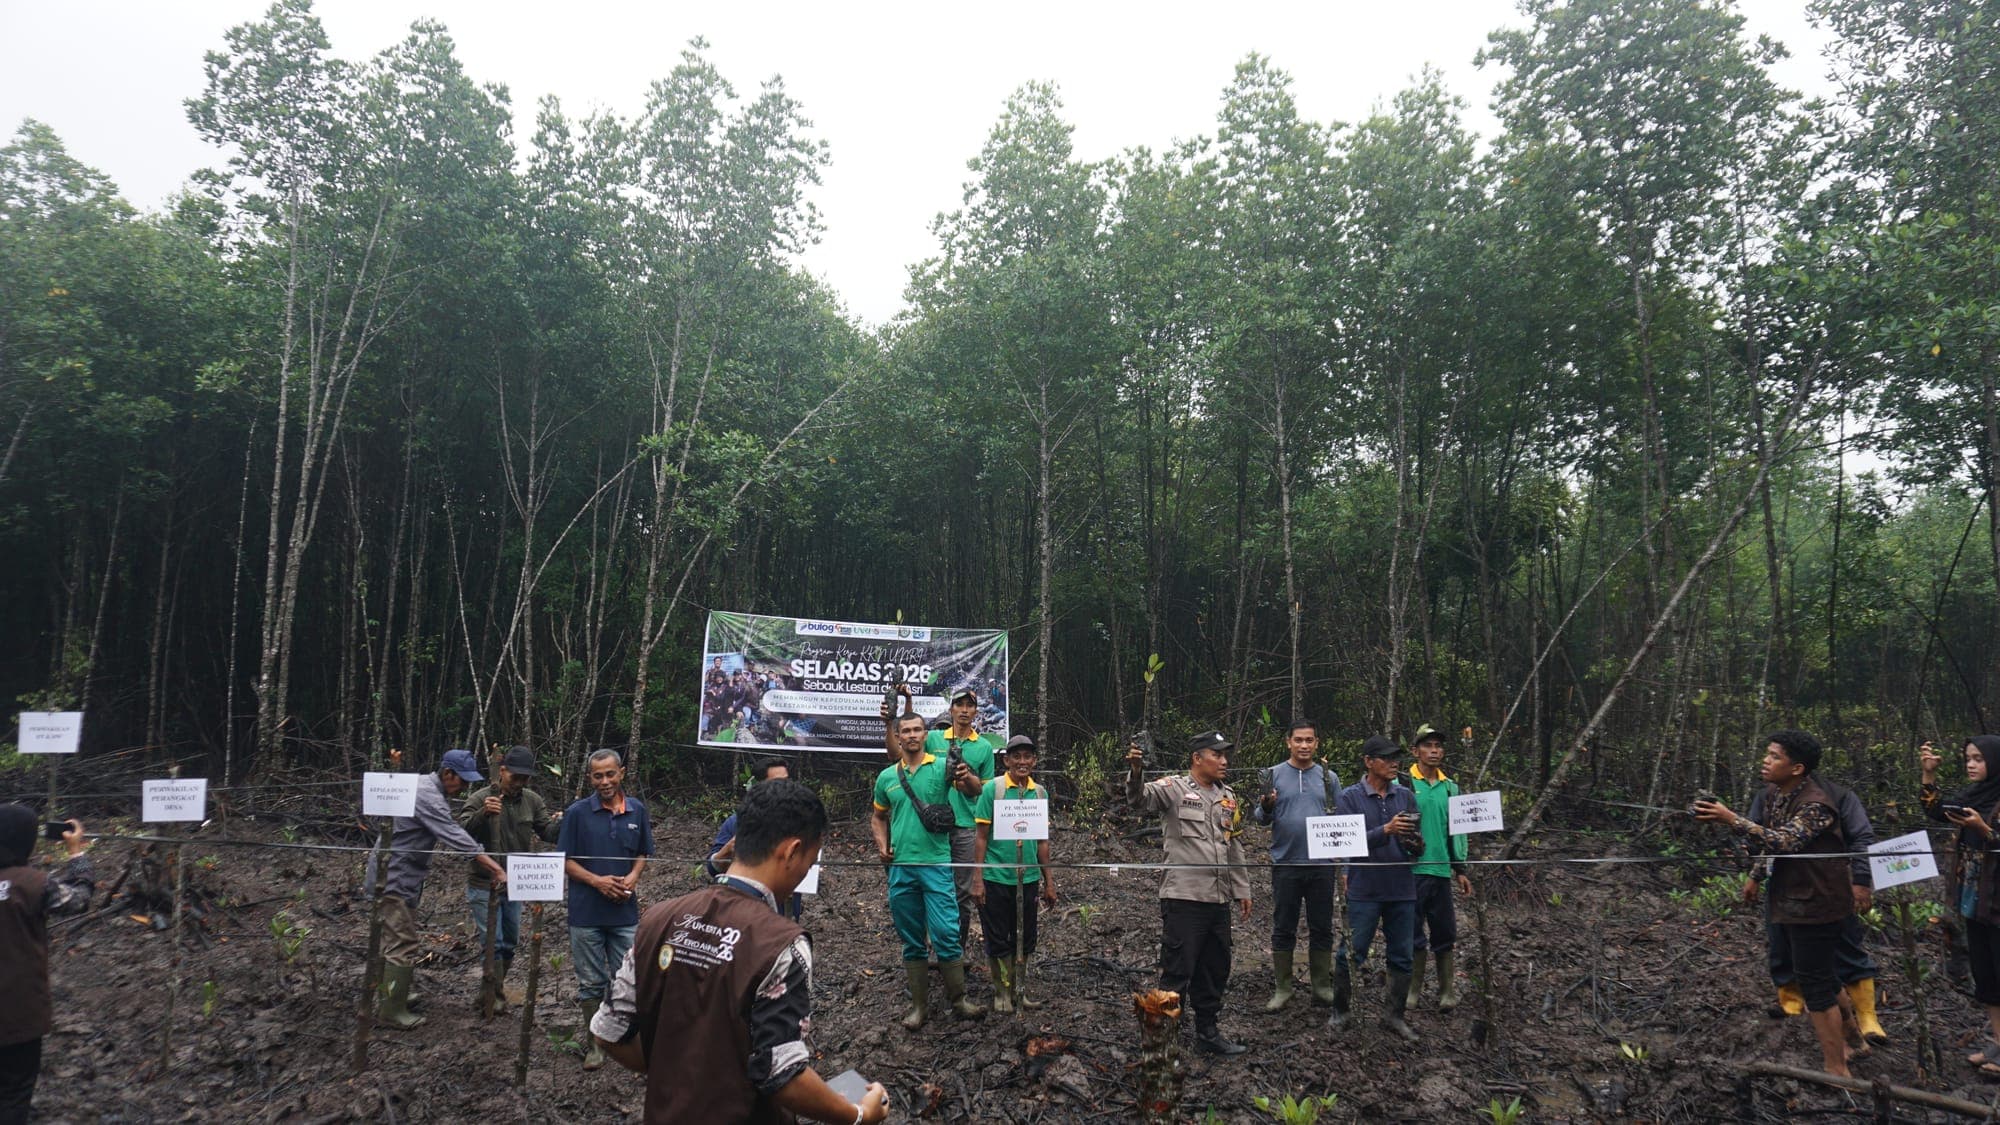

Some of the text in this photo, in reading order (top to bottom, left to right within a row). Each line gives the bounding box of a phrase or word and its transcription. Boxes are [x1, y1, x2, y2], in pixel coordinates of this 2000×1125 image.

[808, 622, 834, 634] bulog
[791, 659, 882, 682] SELARAS
[803, 679, 844, 692] Sebauk
[846, 681, 880, 694] Lestari
[820, 697, 864, 705] KEPEDULIAN
[819, 704, 858, 712] EKOSISTEM
[149, 785, 200, 793] PERWAKILAN
[151, 794, 196, 802] PERANGKAT
[1460, 798, 1488, 807] KARANG
[1462, 806, 1489, 815] TARUNA
[1453, 815, 1497, 825] DESA SEBAUK
[1311, 820, 1360, 830] PERWAKILAN
[1315, 830, 1358, 839] KELOMPOK
[1322, 840, 1354, 848] KEMPAS
[513, 862, 560, 871] PERWAKILAN
[517, 872, 555, 881] KAPOLRES
[516, 883, 556, 891] BENGKALIS
[720, 927, 741, 945] 20
[716, 943, 734, 961] 26
